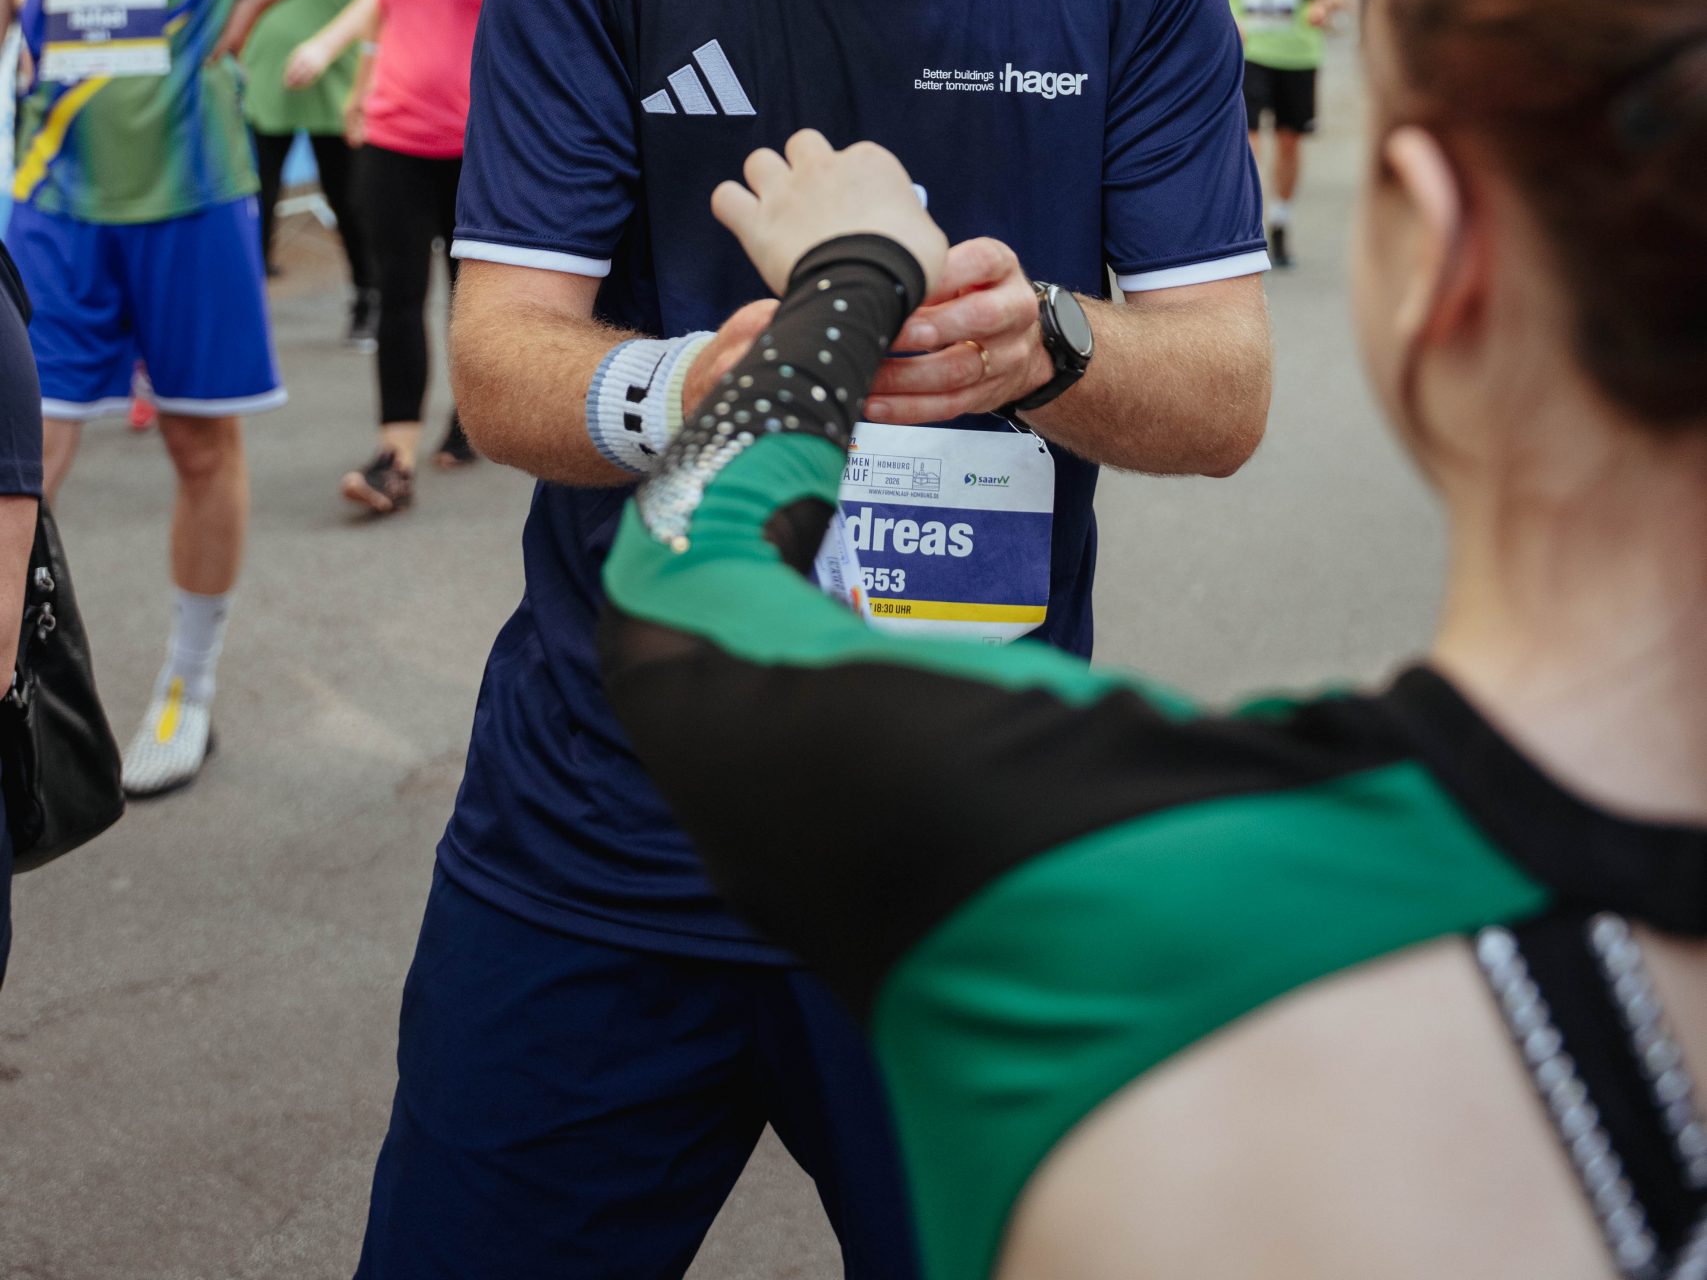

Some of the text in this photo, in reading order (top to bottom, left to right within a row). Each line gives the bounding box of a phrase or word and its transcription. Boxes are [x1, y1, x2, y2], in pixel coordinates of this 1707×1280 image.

[923, 68, 994, 81] Better buildings
[914, 80, 994, 91] Better tomorrows
[877, 460, 911, 470] HOMBURG
[843, 468, 869, 482] AUF
[846, 507, 974, 558] dreas
[874, 603, 894, 613] 18:30
[896, 604, 912, 614] UHR
